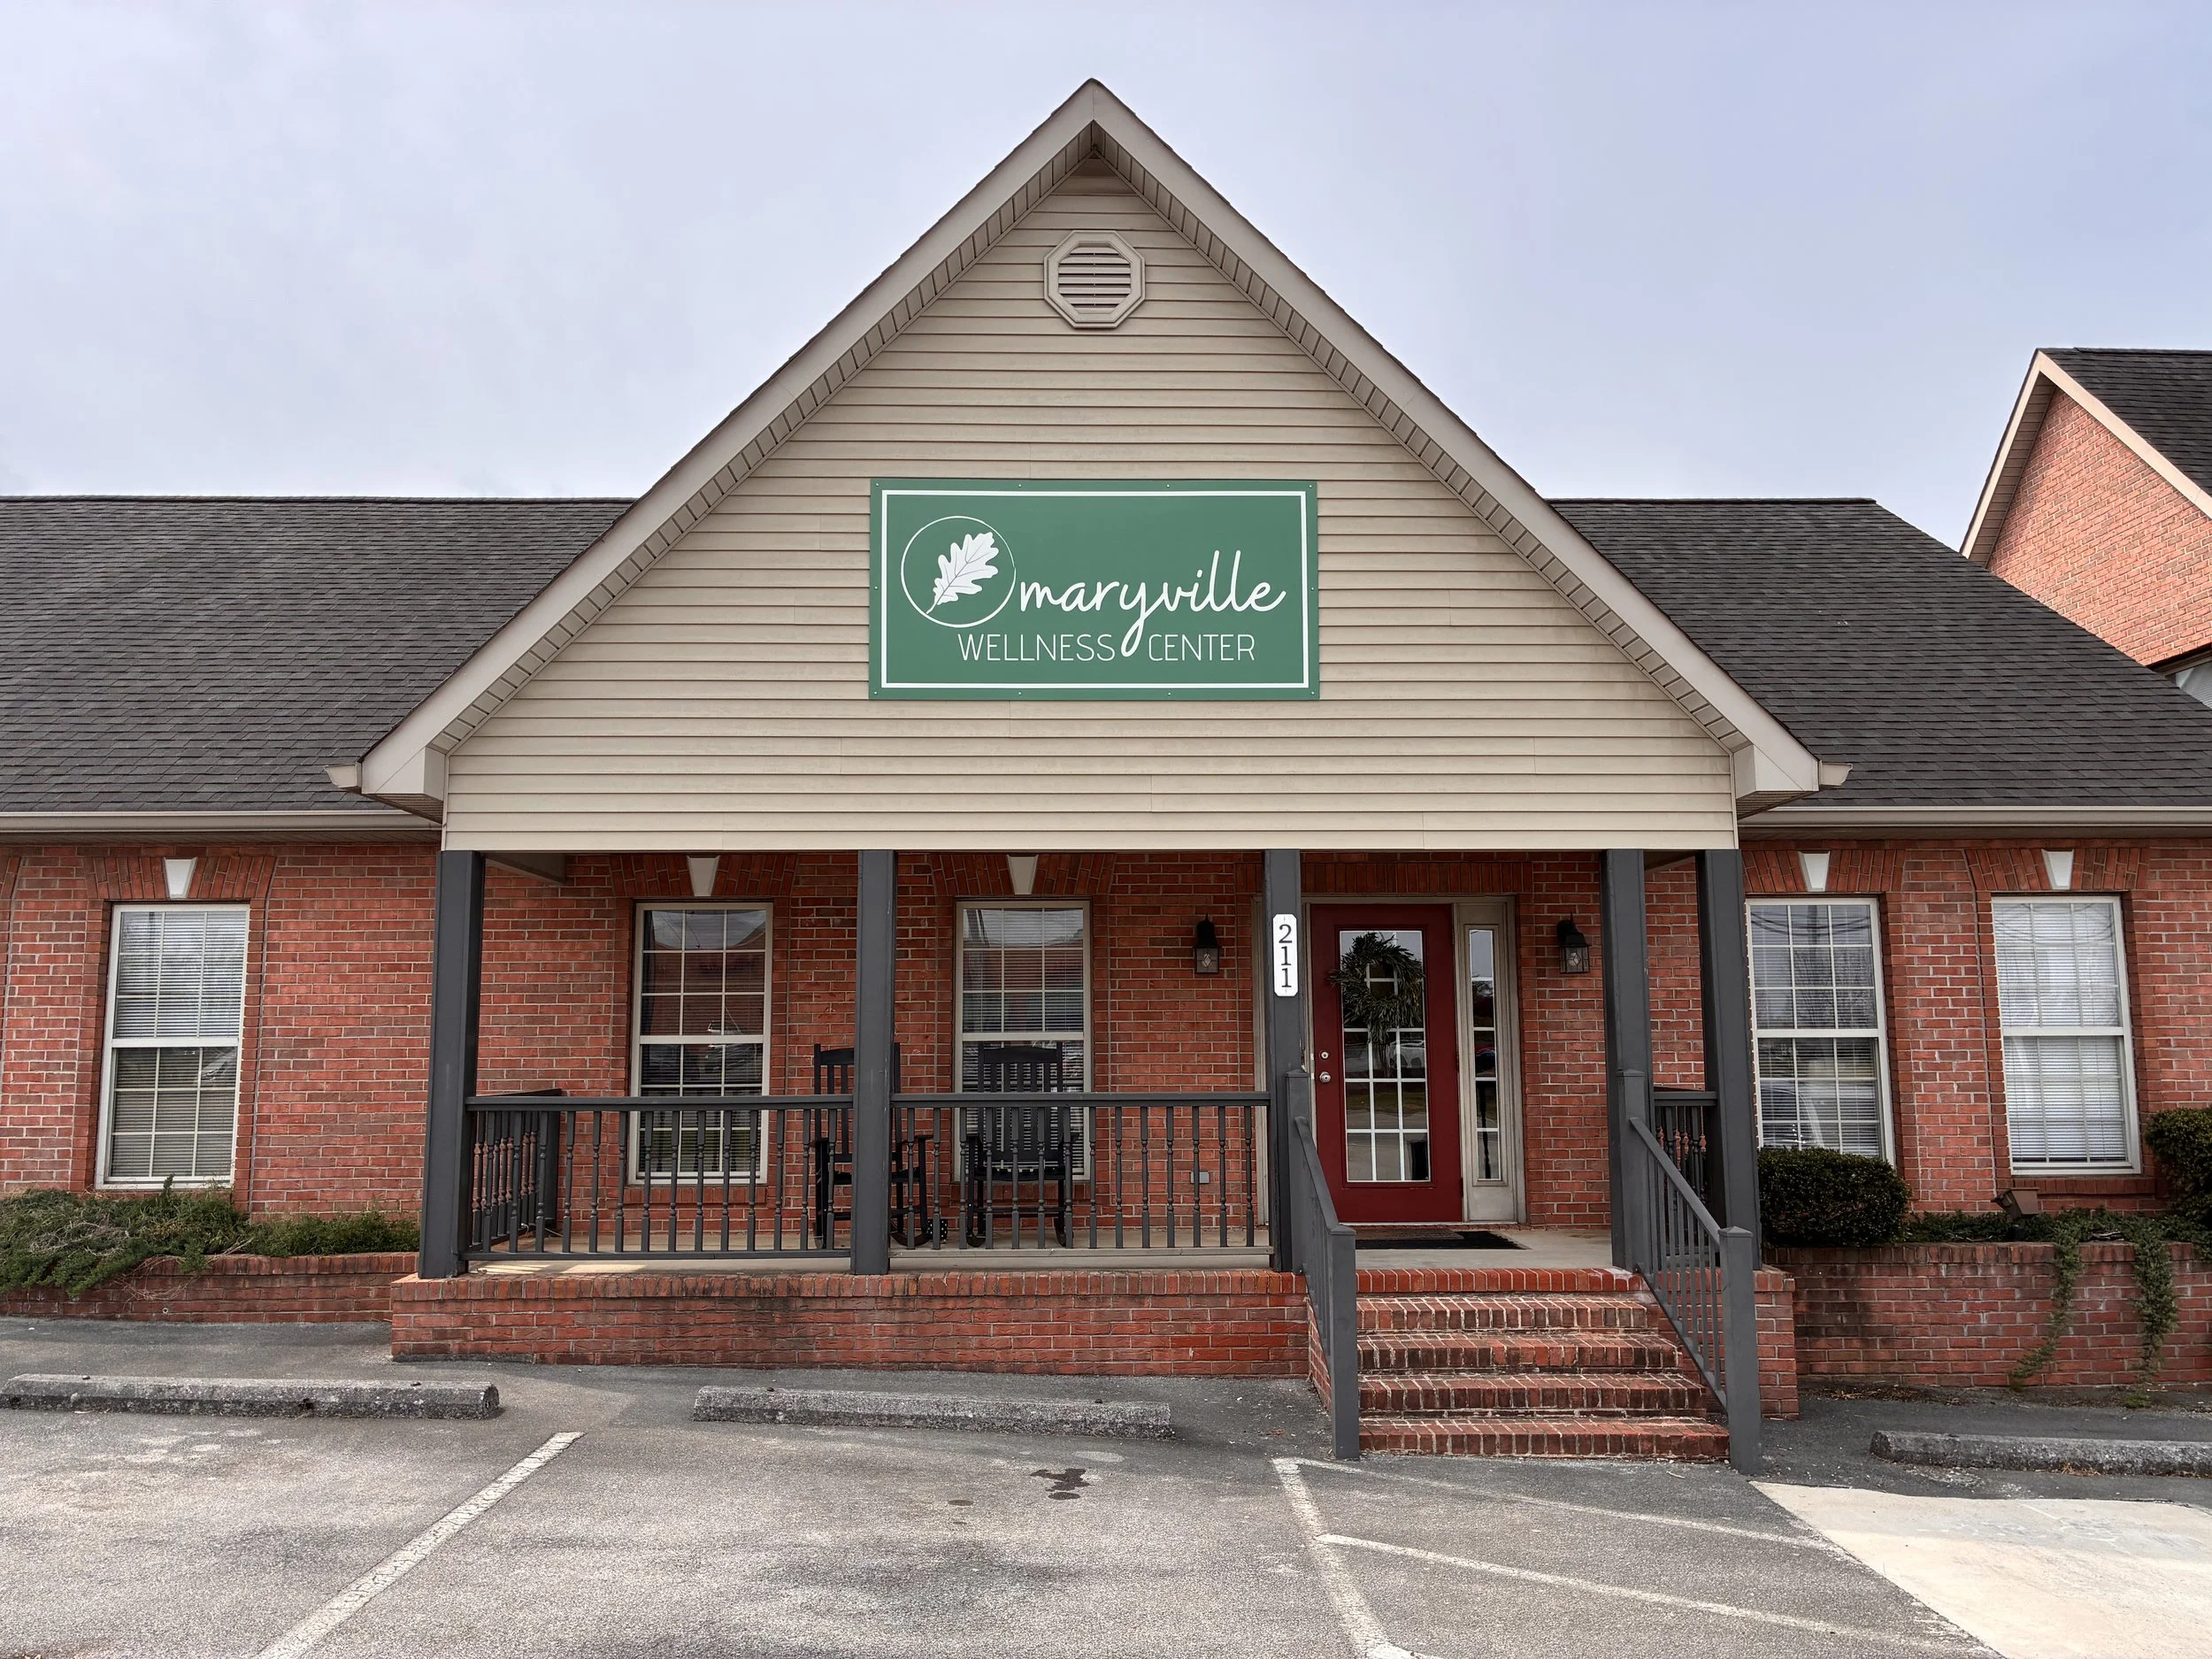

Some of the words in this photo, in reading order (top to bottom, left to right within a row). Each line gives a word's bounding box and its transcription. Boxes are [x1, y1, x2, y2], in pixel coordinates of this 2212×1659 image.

[1019, 549, 1286, 657] maryville
[957, 633, 1116, 662] WELLNESS
[1148, 633, 1256, 662] CENTER
[1278, 923, 1293, 988] 211
